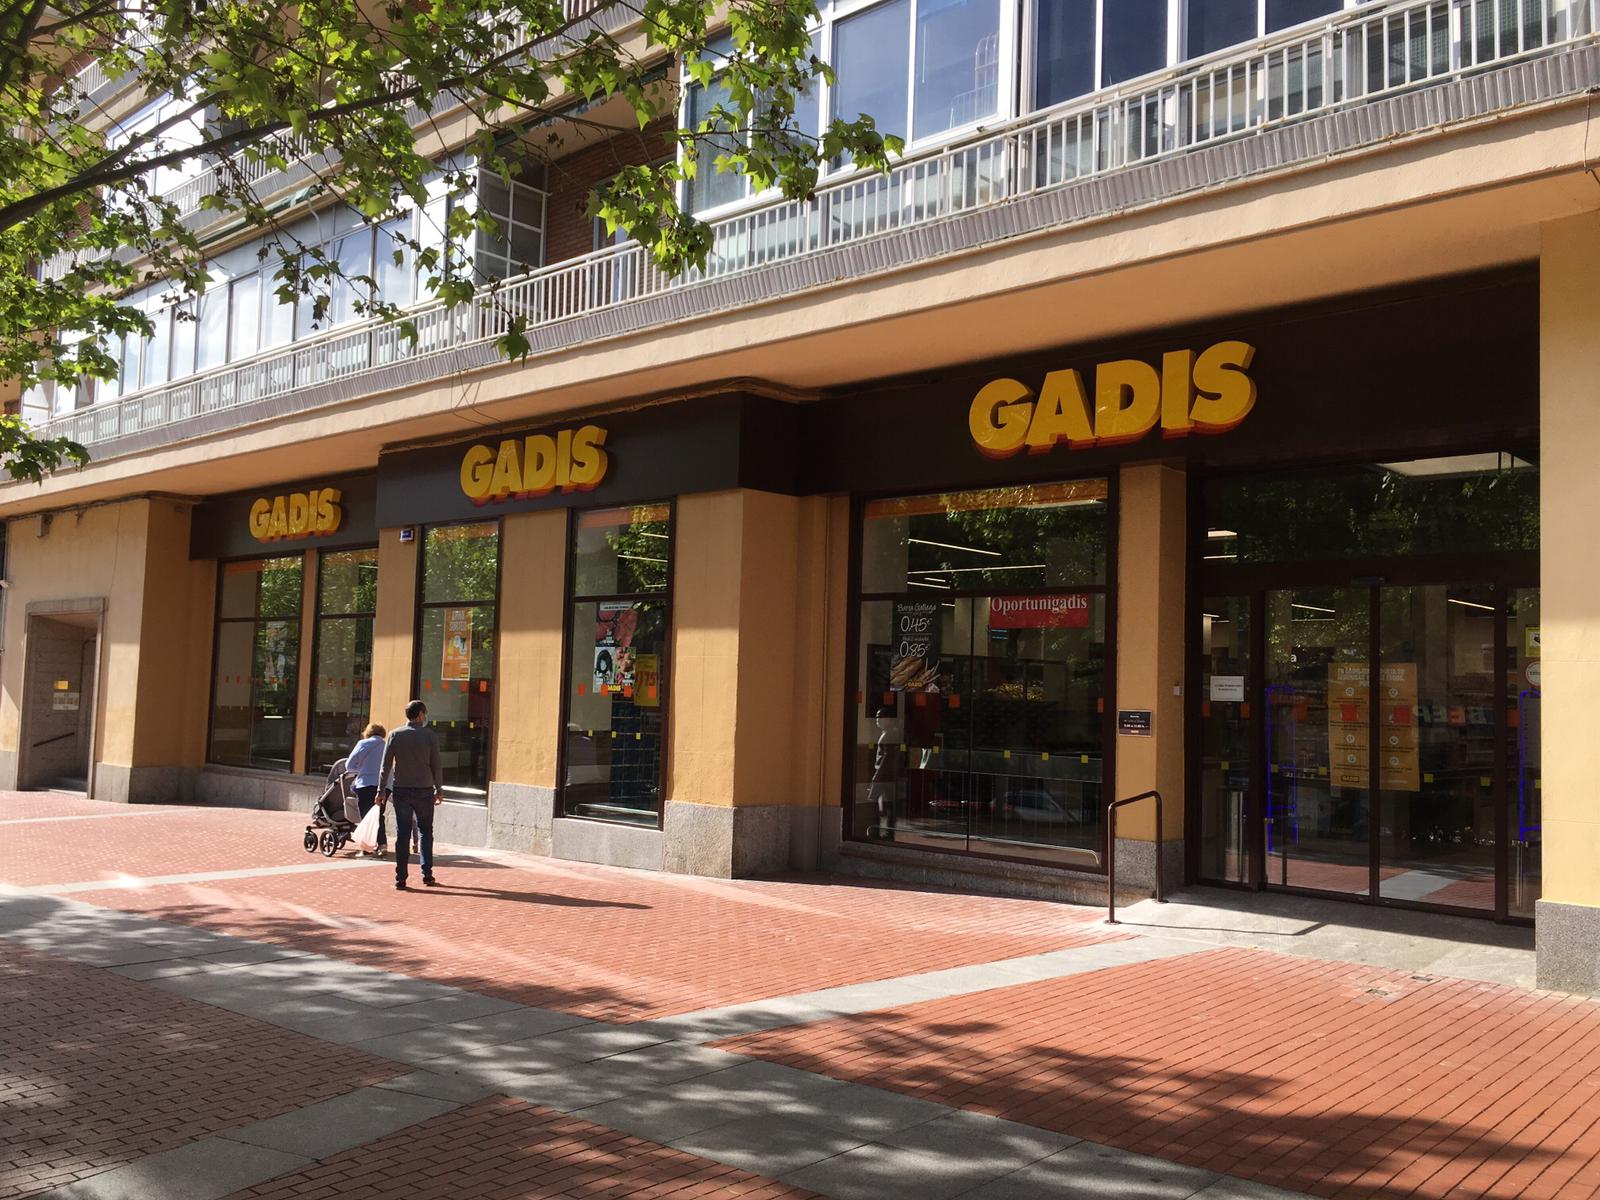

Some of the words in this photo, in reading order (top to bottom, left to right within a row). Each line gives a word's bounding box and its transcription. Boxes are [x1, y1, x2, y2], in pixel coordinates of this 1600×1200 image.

[969, 341, 1256, 455] GADIS
[461, 425, 608, 503] GADIS
[249, 488, 341, 542] GADIS
[991, 594, 1088, 615] Oportunigadis
